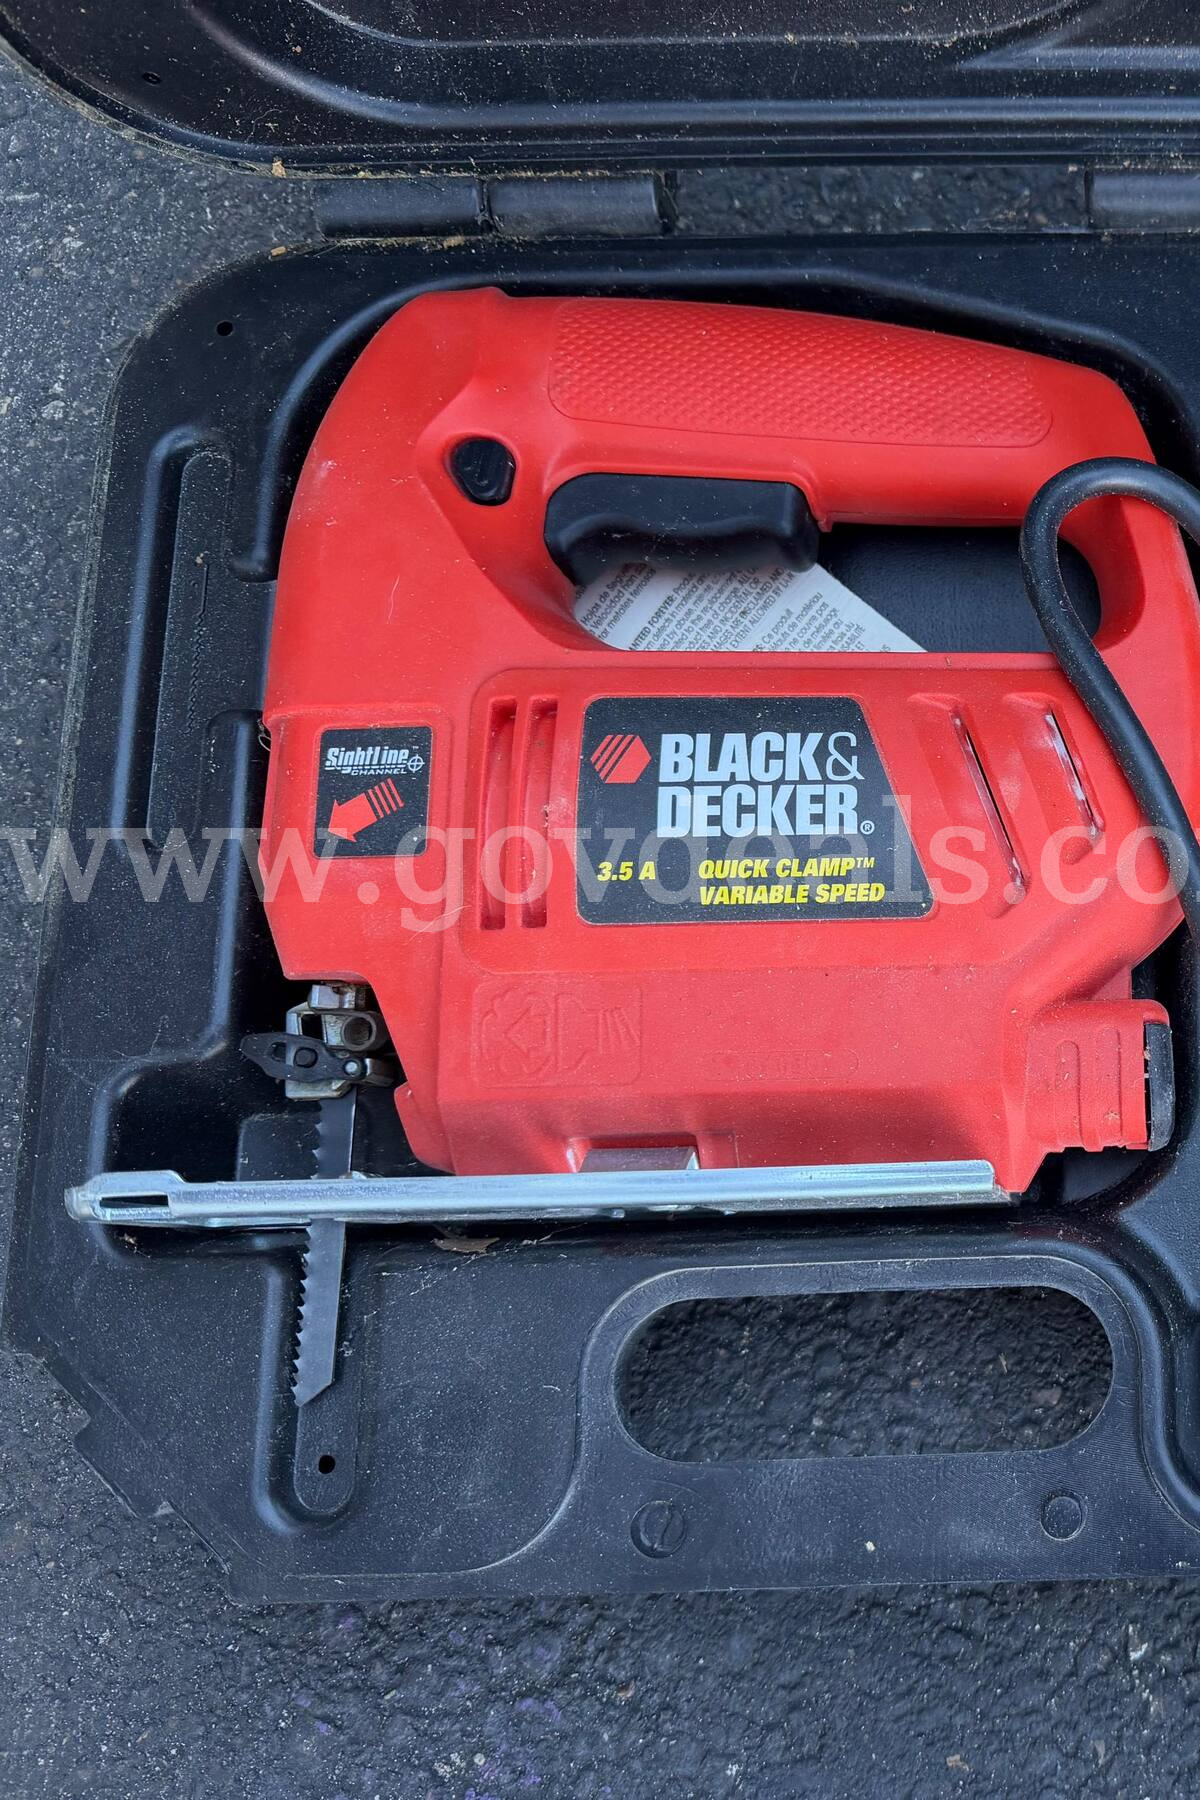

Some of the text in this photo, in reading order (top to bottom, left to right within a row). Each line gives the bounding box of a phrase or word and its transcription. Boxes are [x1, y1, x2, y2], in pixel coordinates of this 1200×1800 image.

[646, 592, 678, 627] FOREVER:
[351, 768, 407, 776] CHANNEL
[597, 862, 633, 881] 3.5
[638, 862, 657, 881] A
[698, 859, 769, 879] QUICK
[698, 882, 885, 906] VARIABLE SPEED
